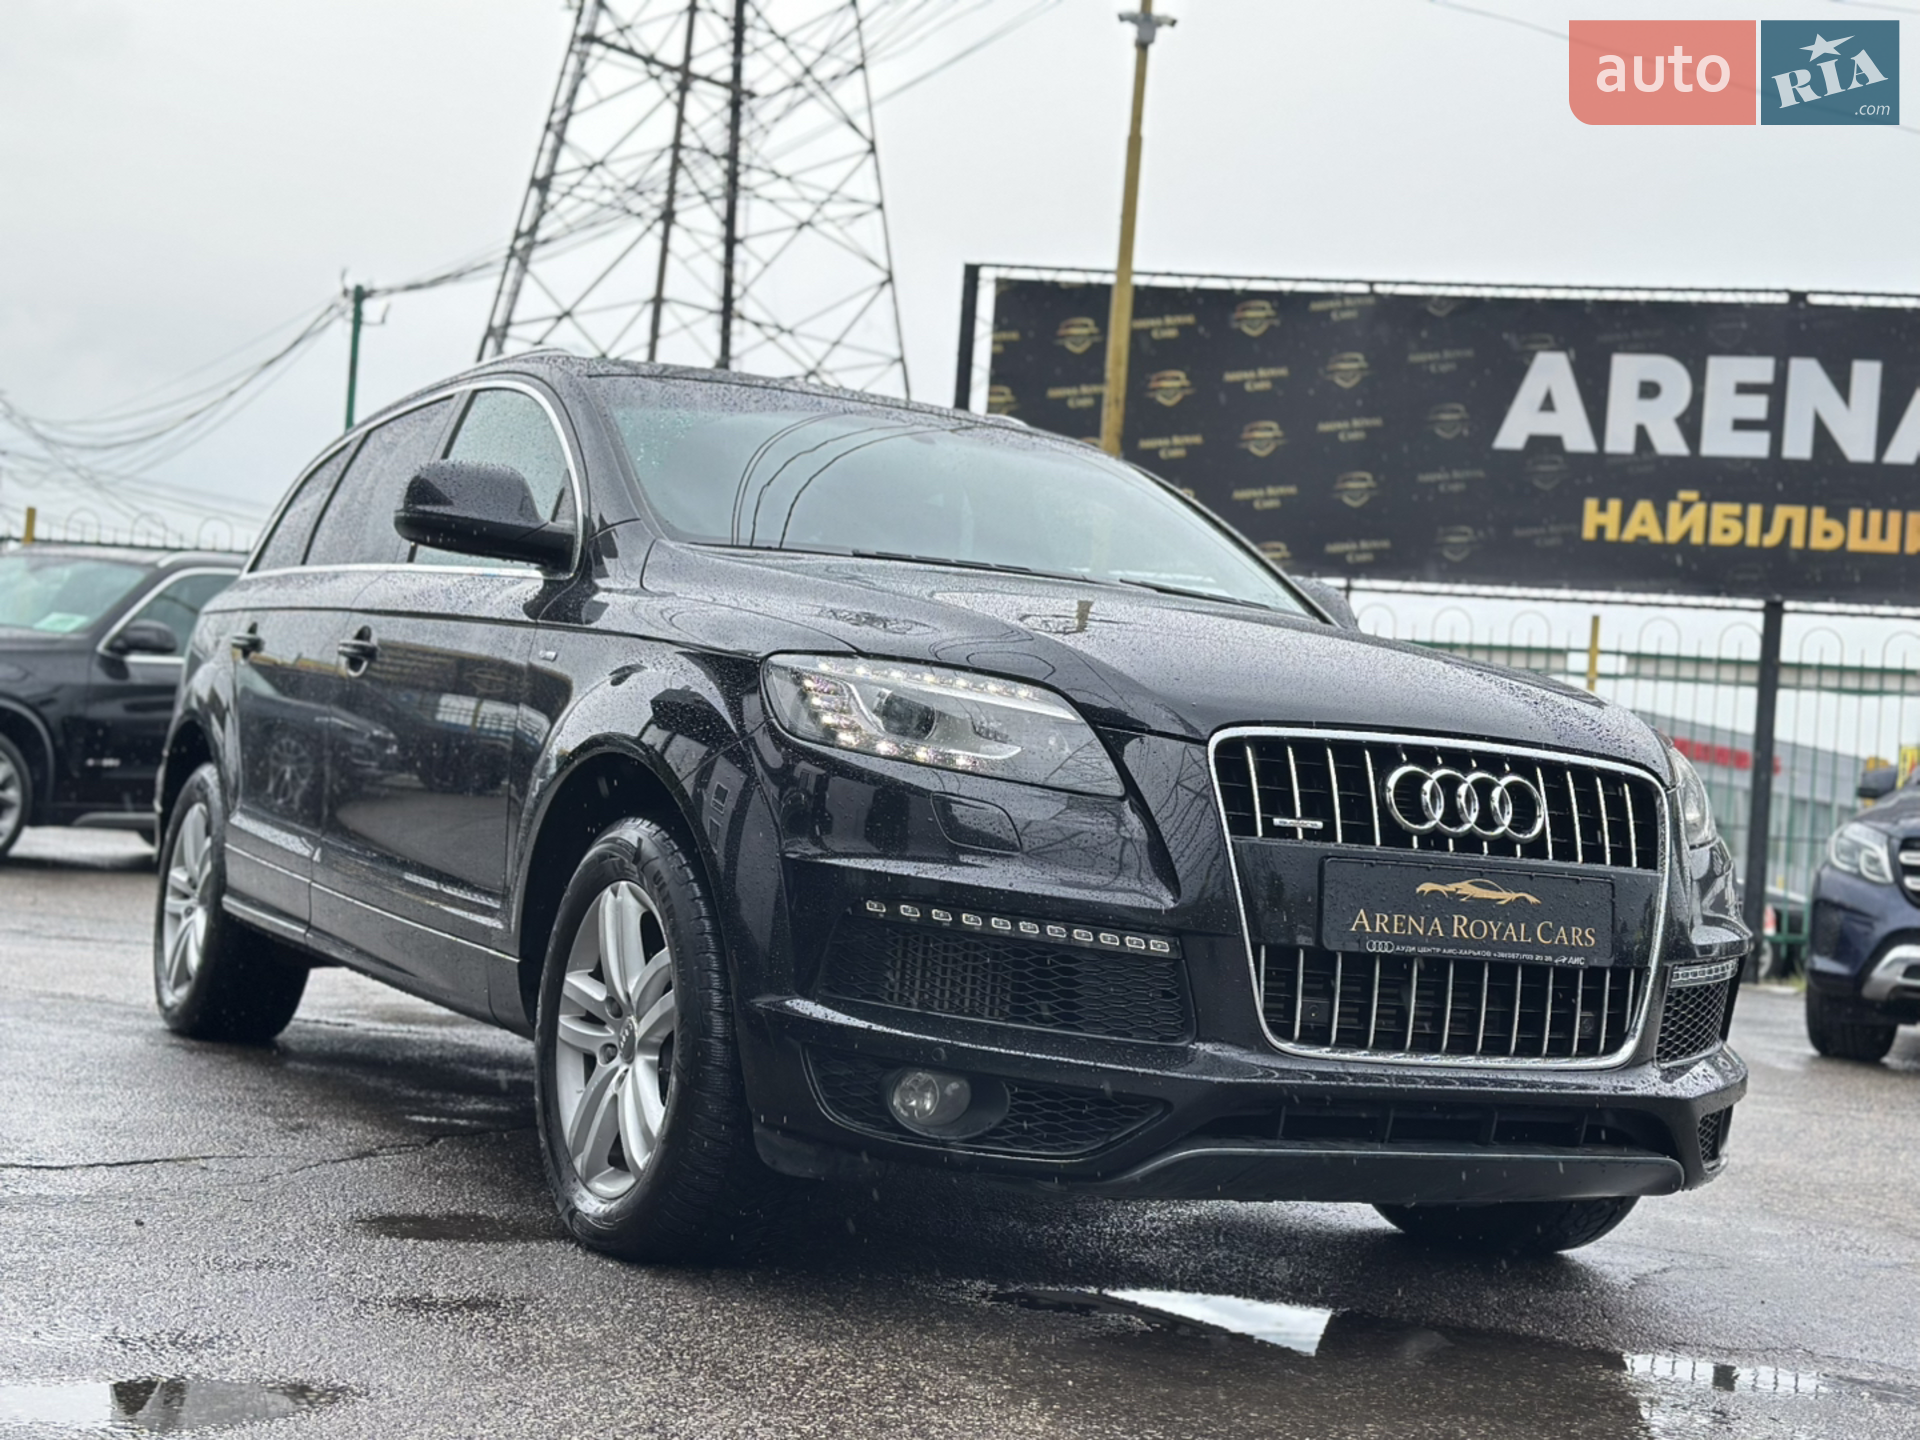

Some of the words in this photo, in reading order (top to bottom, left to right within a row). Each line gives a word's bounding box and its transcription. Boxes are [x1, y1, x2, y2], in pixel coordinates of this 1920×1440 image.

[1350, 908, 1445, 937] ARENA
[1451, 914, 1532, 943] ROYAL
[1536, 921, 1597, 948] CARS
